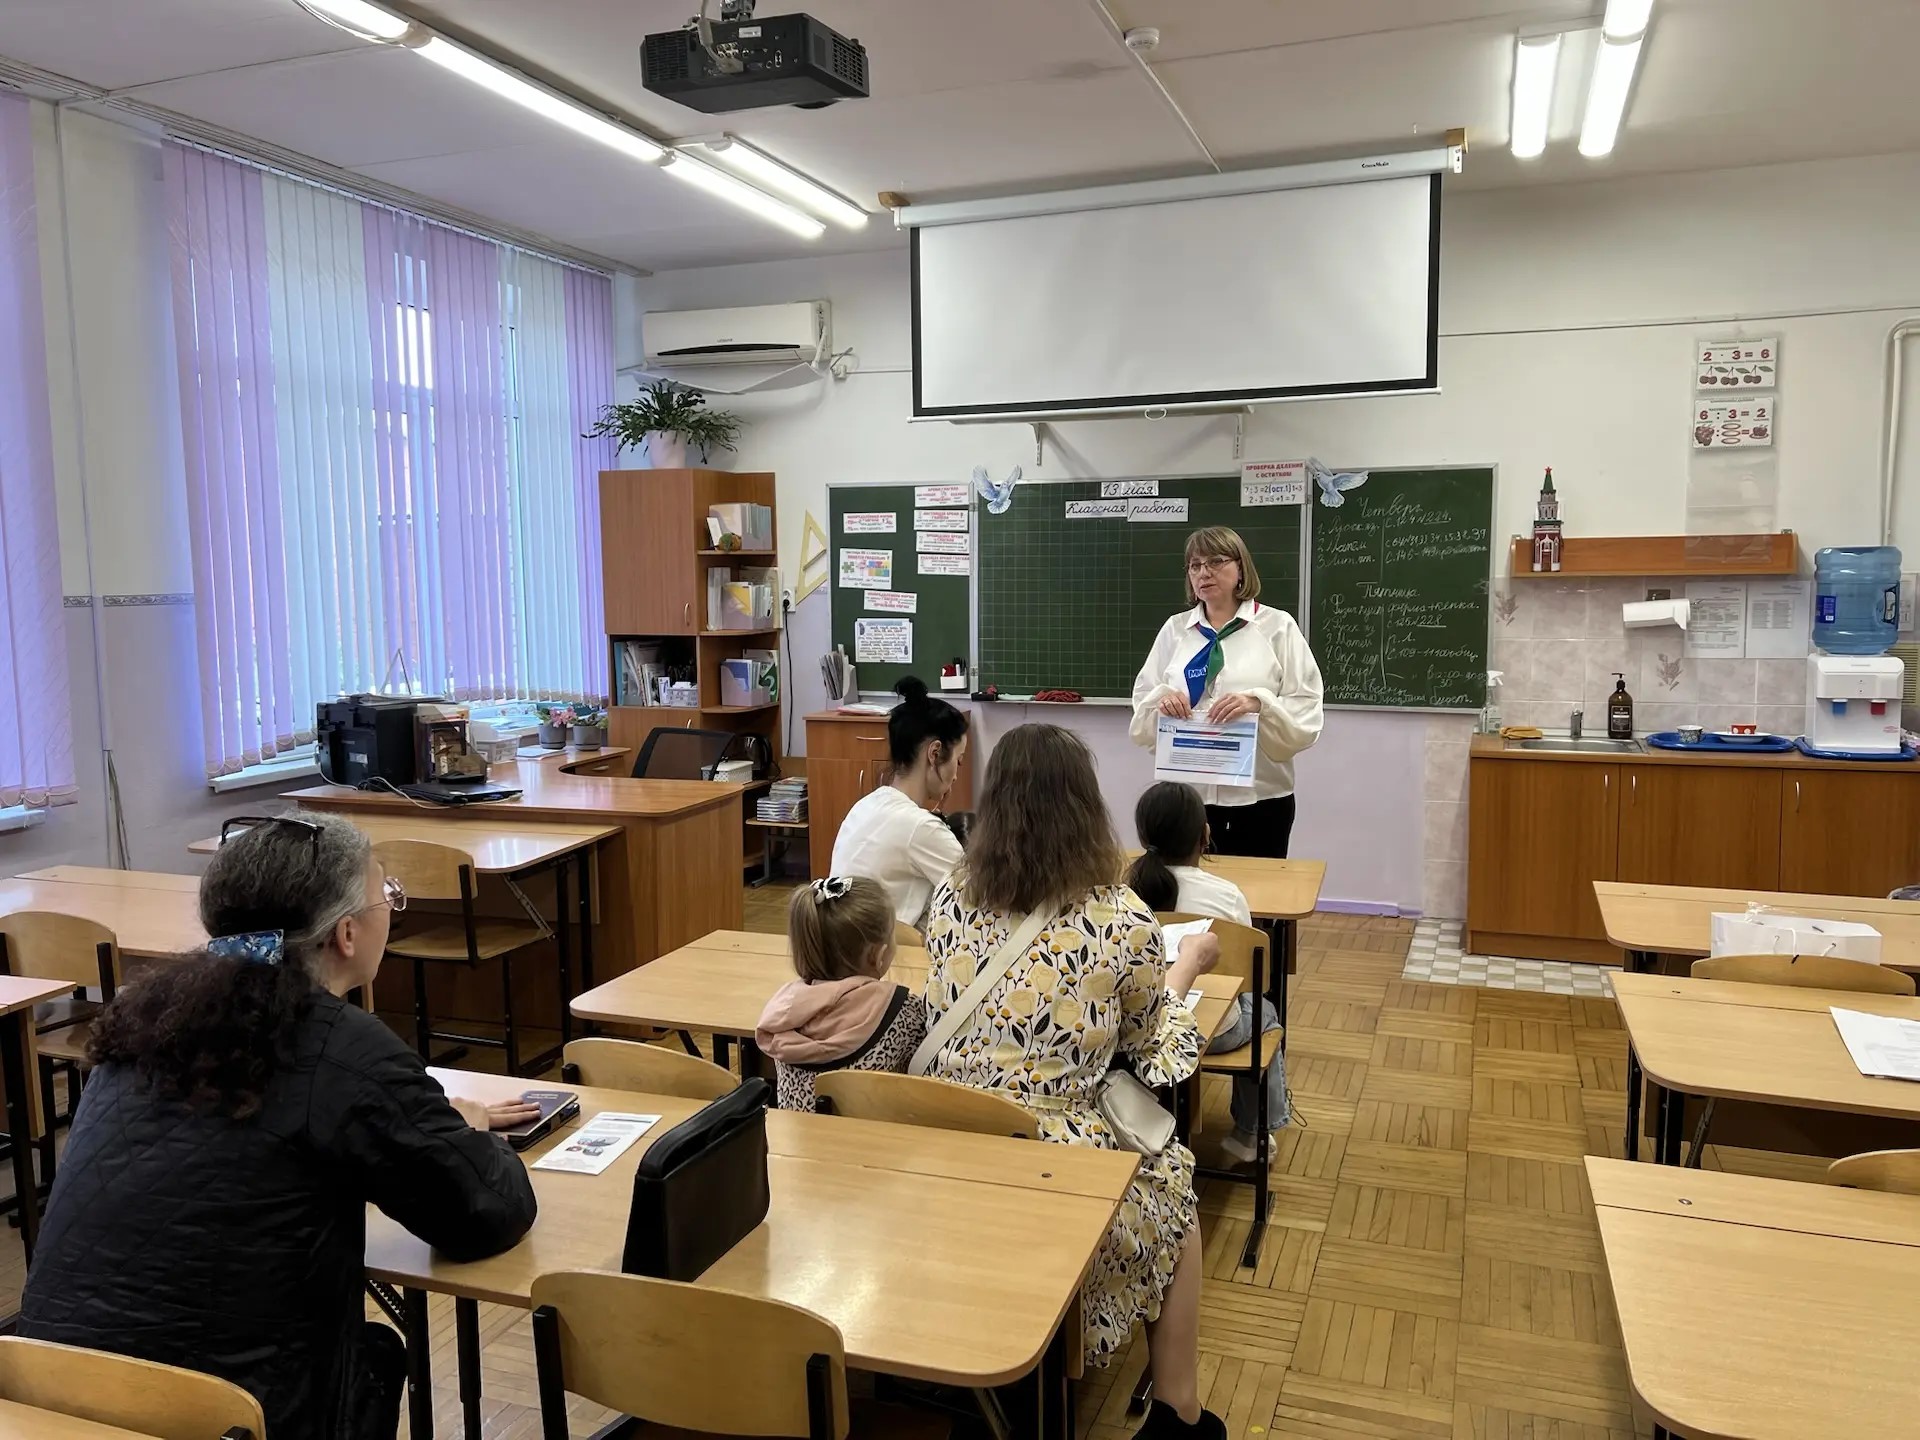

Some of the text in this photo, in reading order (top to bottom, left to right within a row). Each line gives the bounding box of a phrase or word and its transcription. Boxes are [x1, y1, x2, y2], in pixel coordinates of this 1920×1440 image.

[1703, 352, 1712, 361] 2
[1732, 350, 1741, 360] 3
[1761, 349, 1770, 358] 6
[1699, 410, 1708, 420] 6
[1728, 409, 1737, 419] 3
[1756, 408, 1766, 418] 2
[1103, 483, 1120, 496] 13
[1066, 501, 1127, 514] Классная
